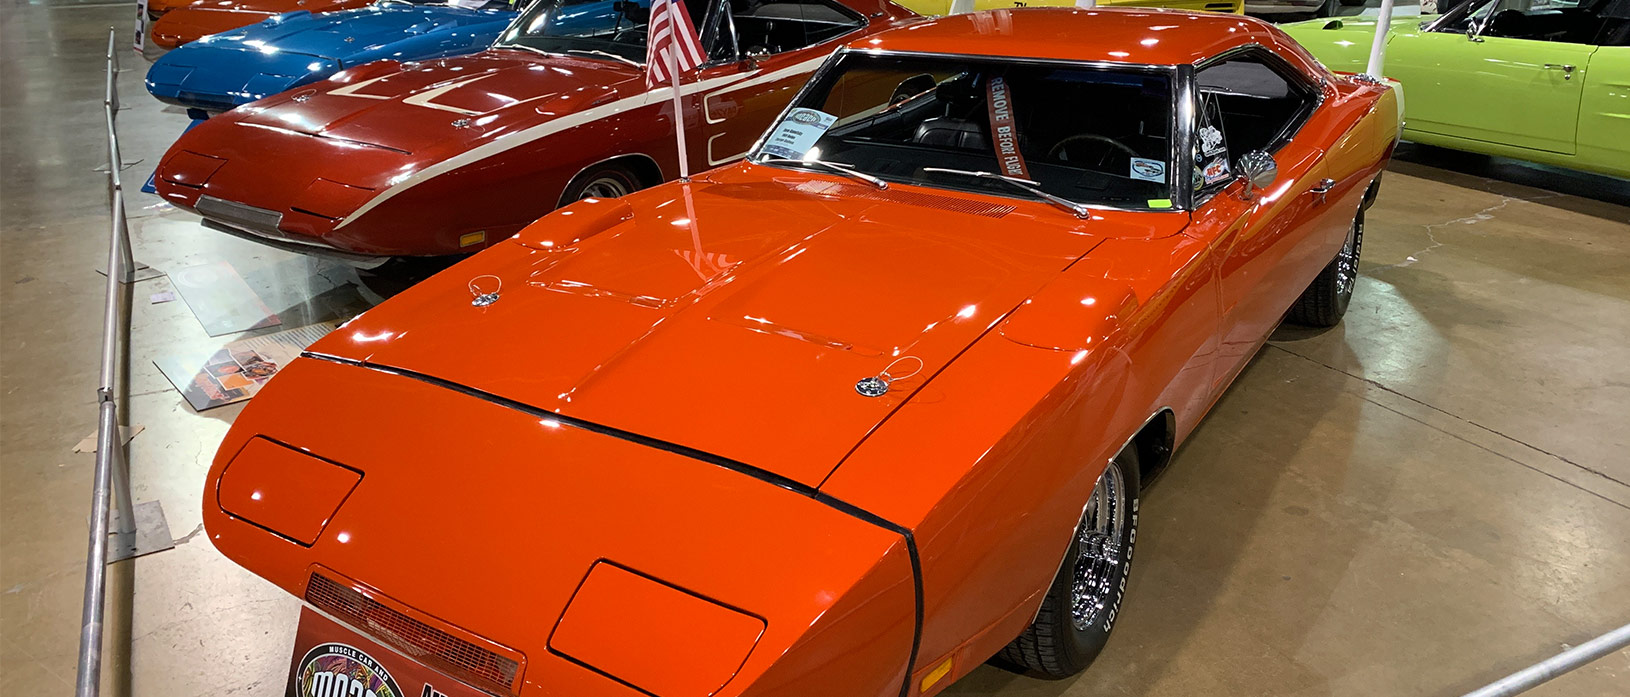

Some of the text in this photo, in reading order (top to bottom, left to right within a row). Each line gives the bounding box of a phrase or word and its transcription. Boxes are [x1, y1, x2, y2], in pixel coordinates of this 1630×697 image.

[992, 77, 1009, 120] REMOVE
[998, 126, 1015, 154] BEFORE
[1103, 498, 1139, 632] BFGoodrich
[329, 646, 388, 681] MUSCLE CAR AND
